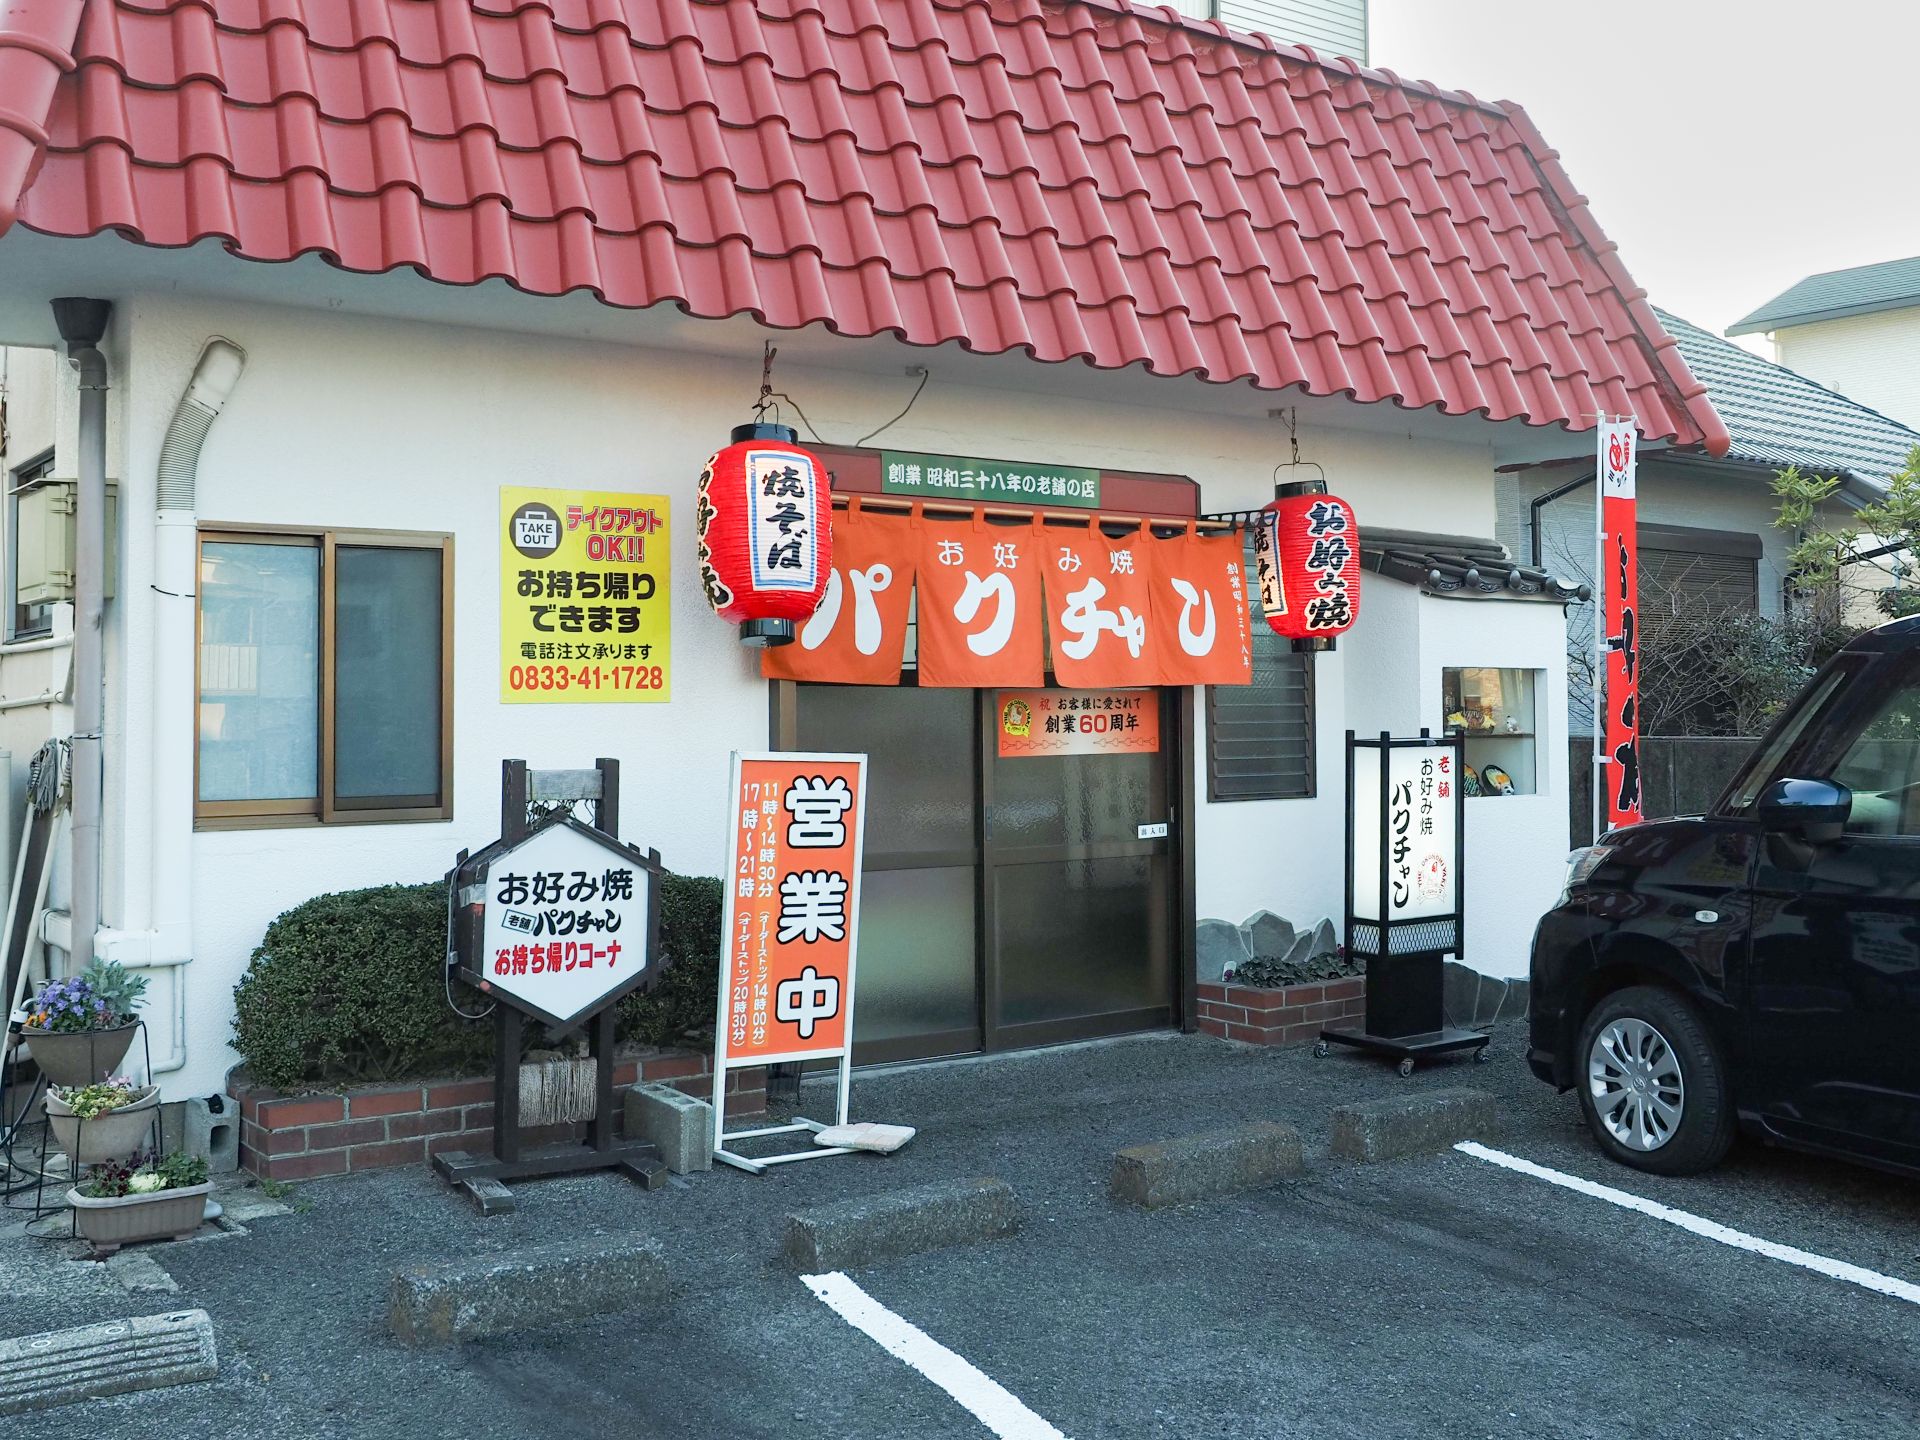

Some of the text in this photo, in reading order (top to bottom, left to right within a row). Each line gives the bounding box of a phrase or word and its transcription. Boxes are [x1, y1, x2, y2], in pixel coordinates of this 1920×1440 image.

[888, 462, 1096, 498] 創業 昭和三十八年の老舗の店
[519, 522, 553, 534] TAKE
[566, 505, 663, 535] テイクアウト
[762, 465, 808, 570] 焼そば
[523, 534, 550, 545] OUT
[586, 534, 644, 562] OK!!
[1308, 502, 1352, 628] お好み焼
[517, 569, 656, 600] お持ち帰り
[529, 603, 641, 634] できます
[520, 641, 653, 661] 電話注文承ります
[1039, 696, 1142, 711] 祝 お客様に愛されて
[1045, 712, 1140, 734] 創業60周年
[1420, 758, 1434, 836] お好み焼
[1392, 780, 1413, 909] パクチャン
[497, 868, 633, 906] お好み焼
[533, 908, 622, 937] パクチャン
[775, 774, 853, 1040] 営業中
